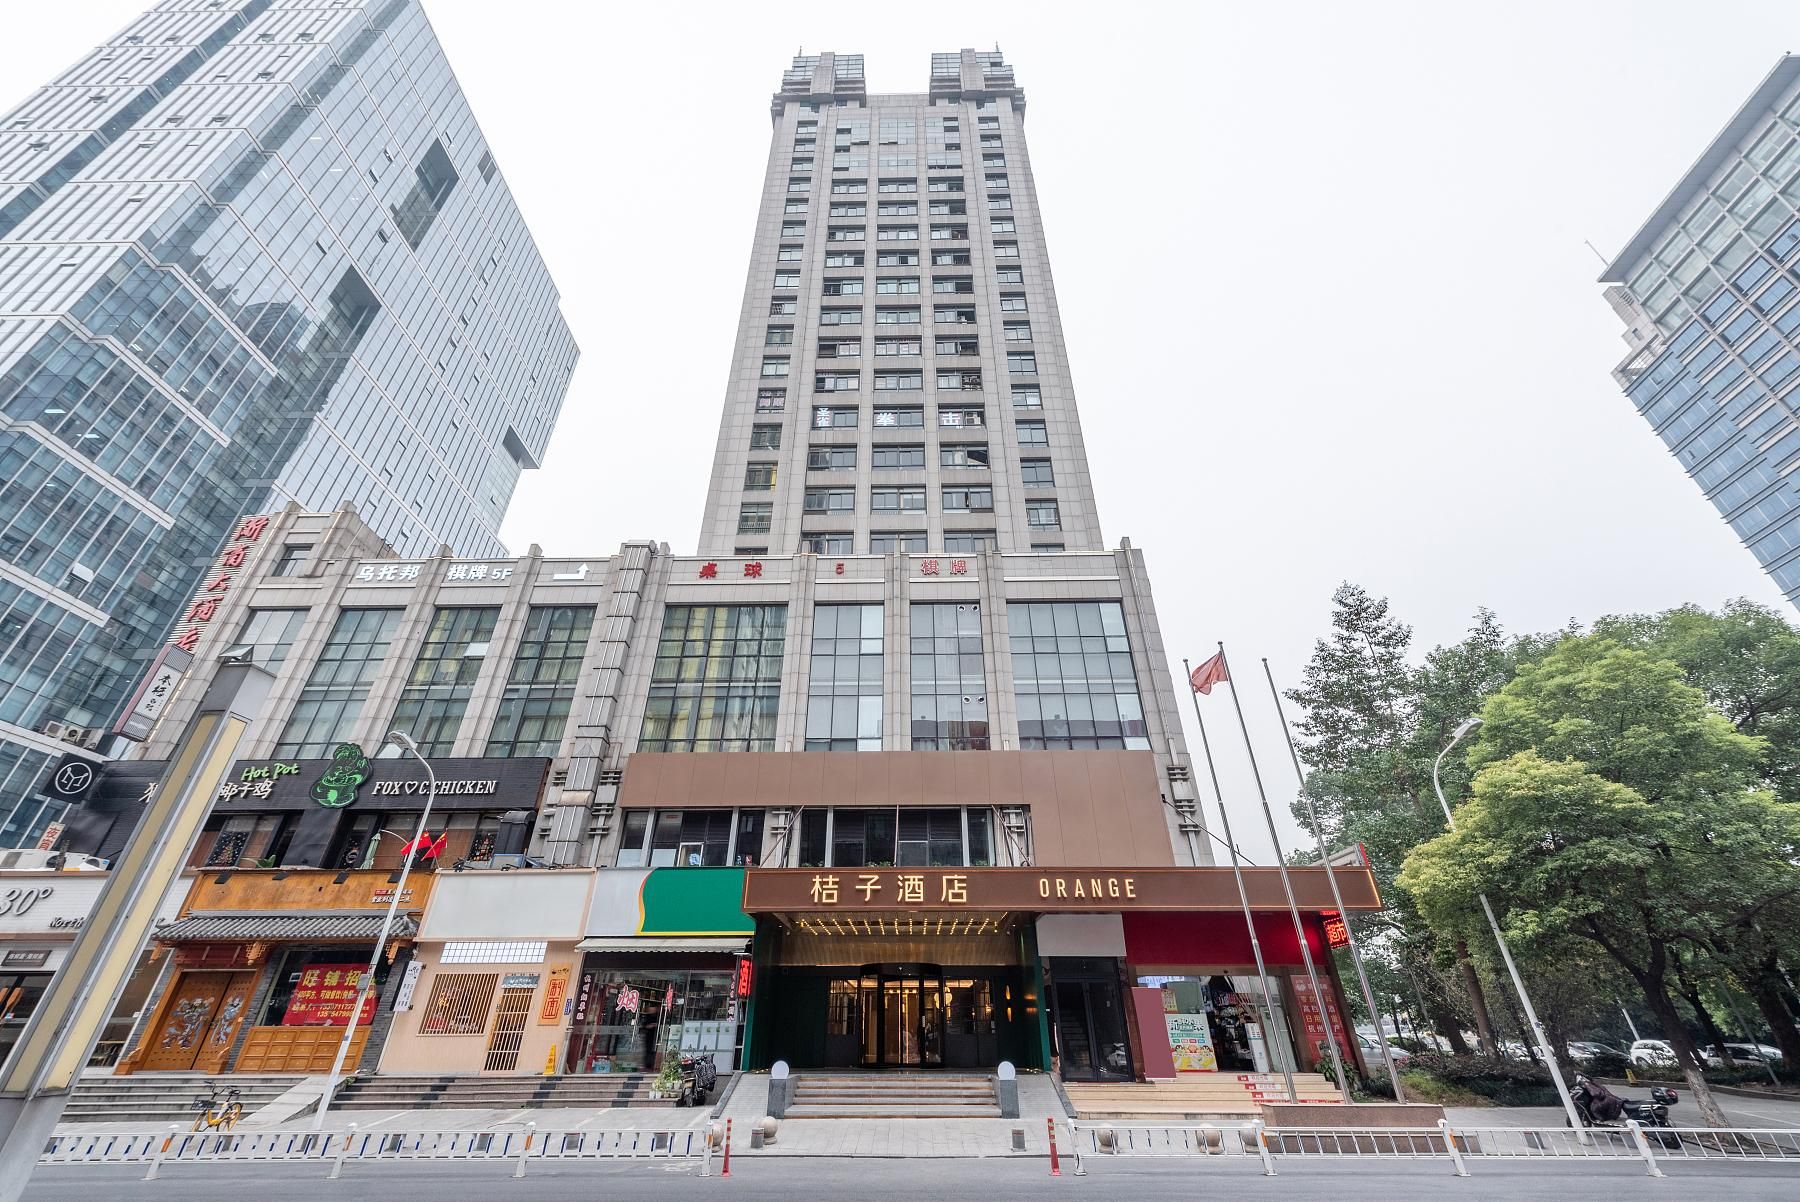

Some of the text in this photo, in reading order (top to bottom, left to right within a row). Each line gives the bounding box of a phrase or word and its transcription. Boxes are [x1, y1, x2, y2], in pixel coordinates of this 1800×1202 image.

[355, 564, 512, 581] 乌托邦 棋牌 5F
[699, 561, 762, 578] 桌球
[921, 559, 967, 576] 棋牌
[240, 762, 299, 780] Hot Pot
[371, 781, 402, 795] FOX
[811, 874, 967, 903] 桔子酒店
[1040, 878, 1137, 898] ORANGE
[1326, 922, 1347, 945] 超市
[616, 984, 639, 1013] 烟
[1303, 1005, 1335, 1013] 高档酒
[1308, 1025, 1340, 1033] 杭州产
